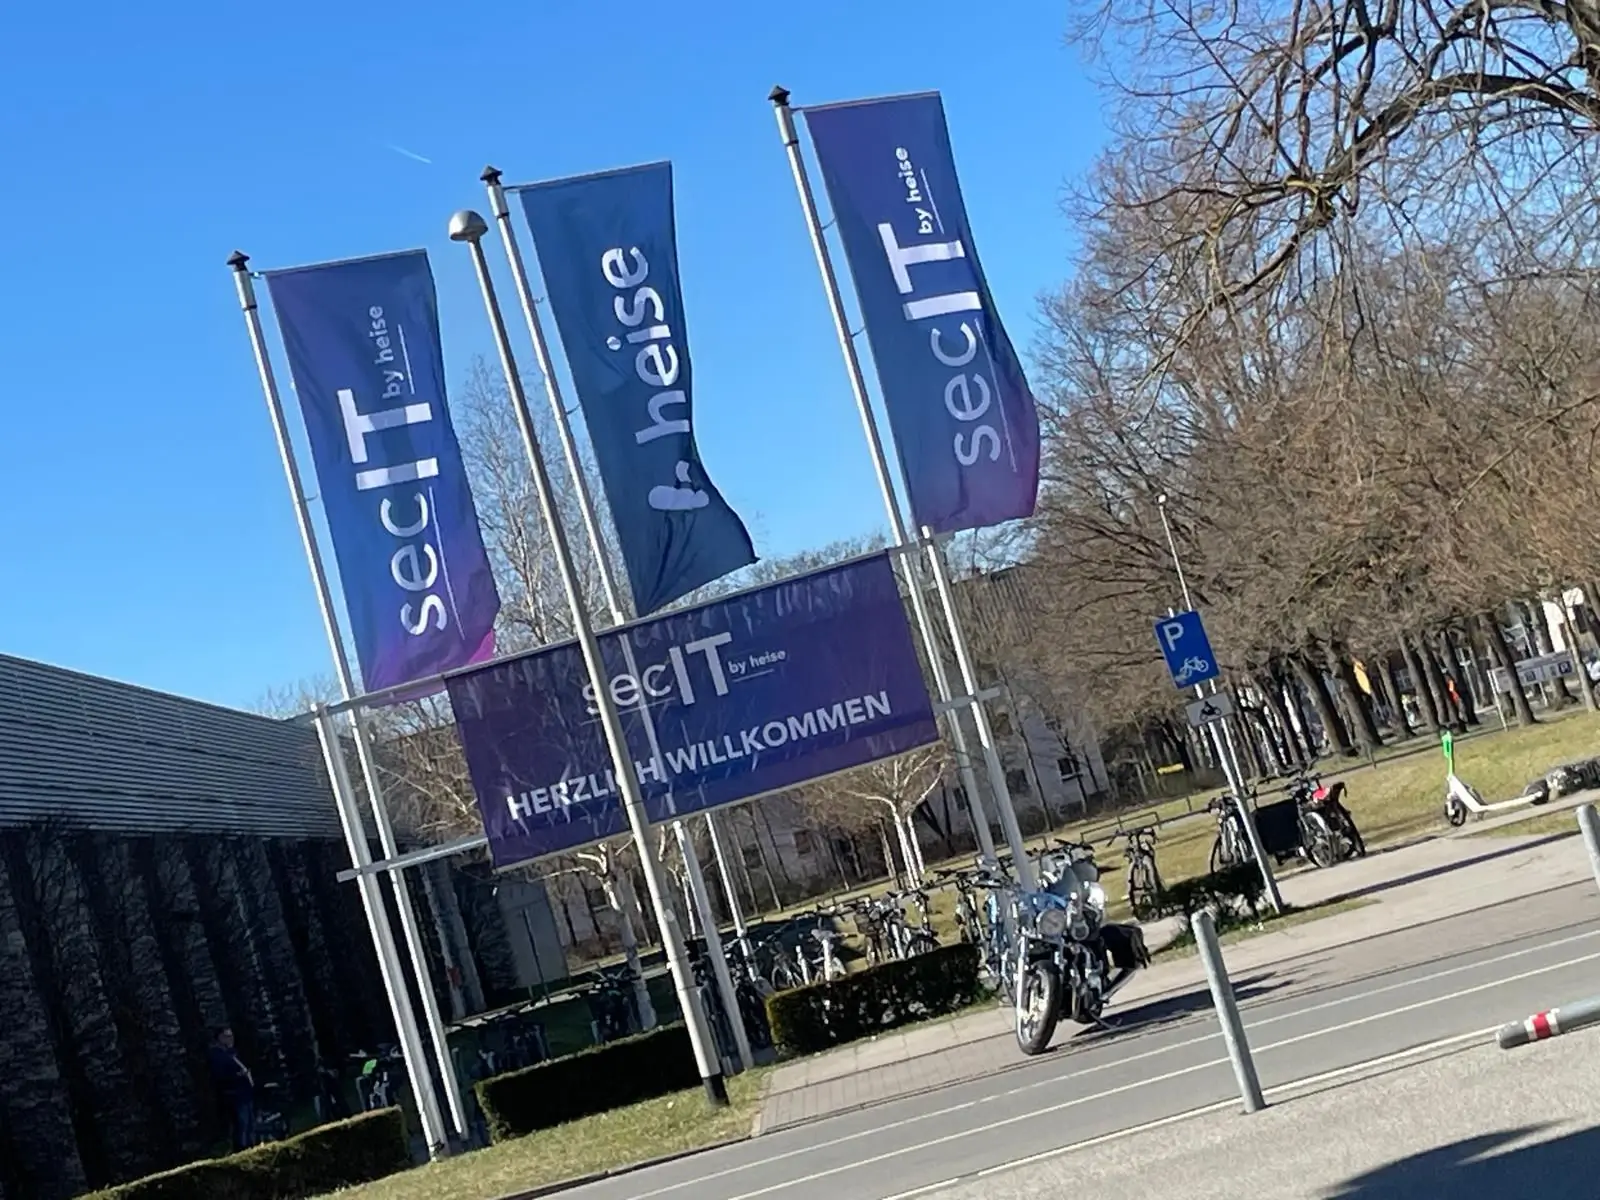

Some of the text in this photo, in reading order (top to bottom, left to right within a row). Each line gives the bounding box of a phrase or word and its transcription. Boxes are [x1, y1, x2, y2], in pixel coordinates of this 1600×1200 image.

[895, 147, 934, 234] by heise
[369, 305, 404, 399] by heise
[601, 246, 691, 445] heise
[877, 222, 1001, 467] secIT
[337, 388, 447, 636] secIT
[728, 661, 746, 675] by
[749, 650, 786, 667] heise
[1162, 622, 1184, 652] P
[507, 691, 891, 820] HERZLIH WILLKOMMEN
